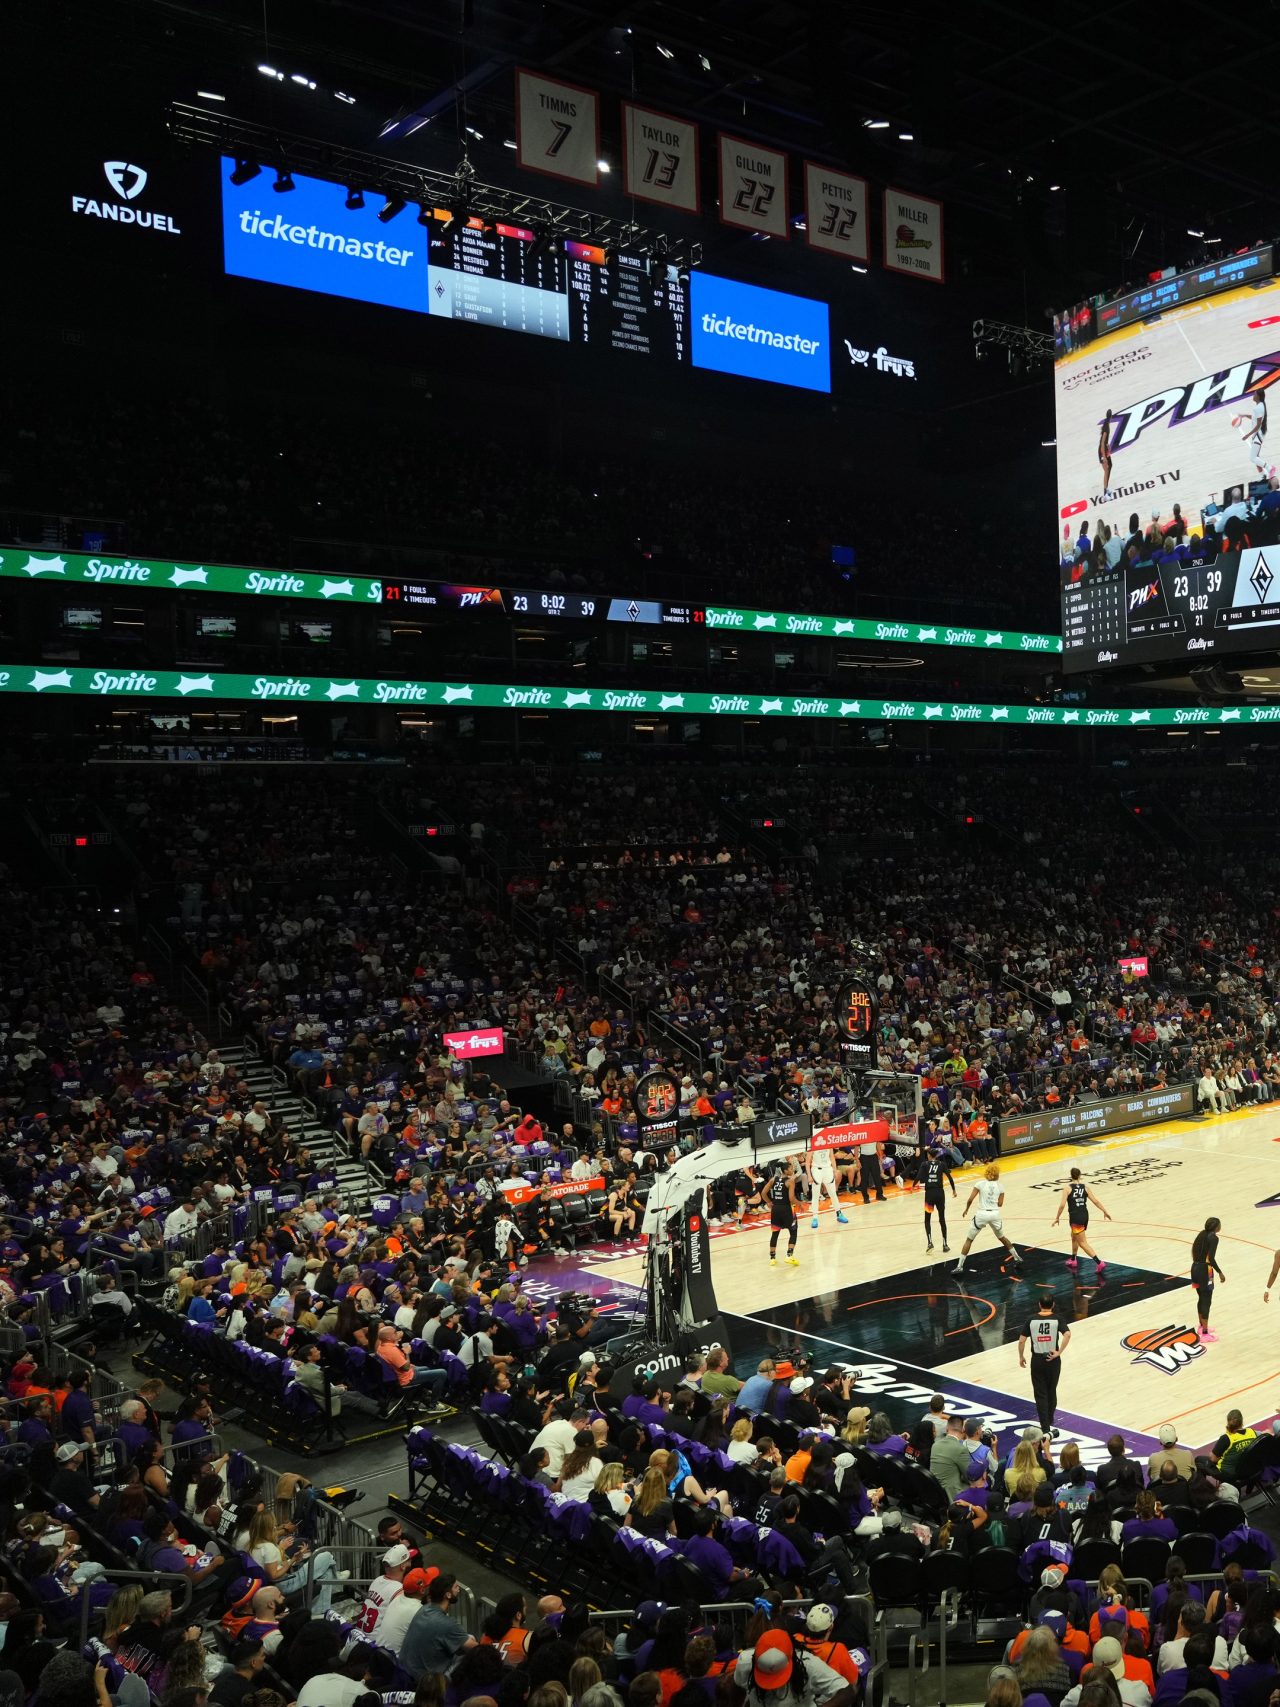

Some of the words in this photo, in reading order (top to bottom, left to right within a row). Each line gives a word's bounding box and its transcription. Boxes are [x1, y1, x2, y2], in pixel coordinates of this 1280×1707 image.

[539, 93, 577, 117] TIMMS
[545, 119, 572, 158] 7
[641, 125, 680, 147] TAYLOR
[643, 147, 680, 189] 13
[736, 155, 771, 177] GILLOM
[733, 176, 775, 217] 22
[822, 182, 852, 201] PETTIS
[72, 196, 181, 234] FANDUEL
[818, 202, 857, 240] 32
[898, 205, 928, 224] MILLER
[240, 211, 413, 266] ticketmaster
[703, 314, 819, 354] ticketmaster
[872, 347, 916, 378] fry's
[1062, 345, 1150, 387] mortgage
[1084, 352, 1153, 384] matchup
[1156, 469, 1180, 484] TV
[84, 560, 150, 581] Sprite
[246, 573, 304, 593] Sprite
[409, 586, 426, 594] FOULS
[1174, 576, 1189, 597] 23
[1207, 571, 1222, 592] 39
[386, 587, 400, 600] 21
[460, 589, 496, 607] PHX
[1128, 579, 1160, 613] PHX
[513, 596, 528, 611] 23
[541, 594, 566, 610] 8:02
[581, 601, 595, 616] 39
[1190, 595, 1208, 611] 8:02
[670, 607, 684, 615] FOULS
[693, 611, 704, 623] 21
[706, 610, 743, 626] Sprite
[786, 617, 822, 632] Sprite
[1195, 615, 1203, 626] 21
[876, 624, 908, 639] Sprite
[945, 630, 975, 644] Sprite
[1021, 636, 1049, 649] Sprite
[1187, 638, 1207, 650] Bally
[90, 672, 156, 693] Sprite
[252, 678, 310, 698] Sprite
[374, 683, 426, 702] Sprite
[504, 688, 551, 706] Sprite
[603, 692, 646, 709] Sprite
[710, 696, 749, 713] Sprite
[792, 700, 828, 715] Sprite
[882, 703, 914, 718] Sprite
[951, 706, 981, 720] Sprite
[1027, 709, 1054, 723] Sprite
[1086, 711, 1119, 725] Sprite
[1174, 710, 1209, 723] Sprite
[848, 1006, 870, 1032] 21
[849, 1043, 871, 1053] TISSOT
[1128, 1101, 1144, 1111] BEARS
[1147, 1092, 1182, 1107] COMMANDERS
[1061, 1114, 1076, 1125] BILLS
[1080, 1109, 1104, 1121] FALCONS
[651, 1120, 679, 1131] TISSOT
[776, 1121, 798, 1130] WNBA
[776, 1127, 799, 1138] APP
[928, 1164, 938, 1173] 14
[514, 1189, 523, 1199] G
[773, 1182, 783, 1191] 25
[1073, 1189, 1084, 1198] 24
[691, 1231, 700, 1263] YouTube
[691, 1264, 701, 1274] TV
[1038, 1323, 1050, 1334] 42
[756, 1505, 771, 1524] 25
[1038, 1523, 1050, 1540] 0
